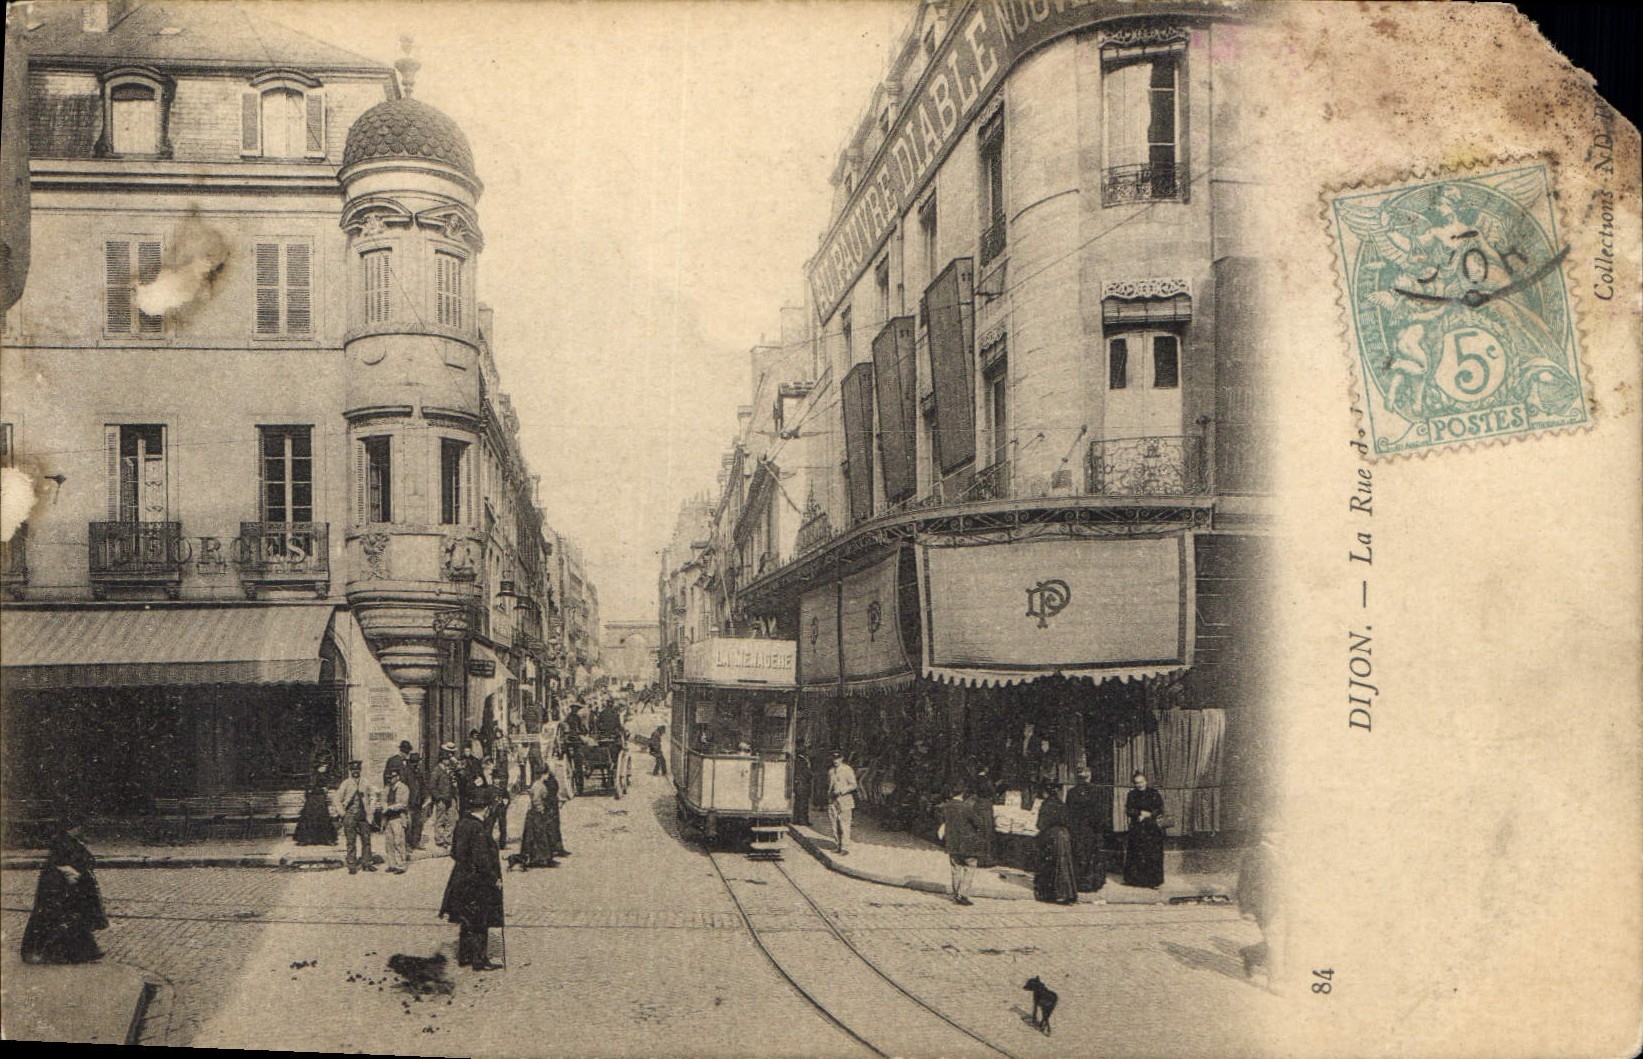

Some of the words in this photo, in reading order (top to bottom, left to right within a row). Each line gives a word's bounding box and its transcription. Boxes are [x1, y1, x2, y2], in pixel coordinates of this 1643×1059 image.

[814, 257, 835, 315] AU
[829, 166, 899, 291] PAUVRE
[891, 10, 999, 199] DIABLE
[1432, 408, 1525, 443] POSTES
